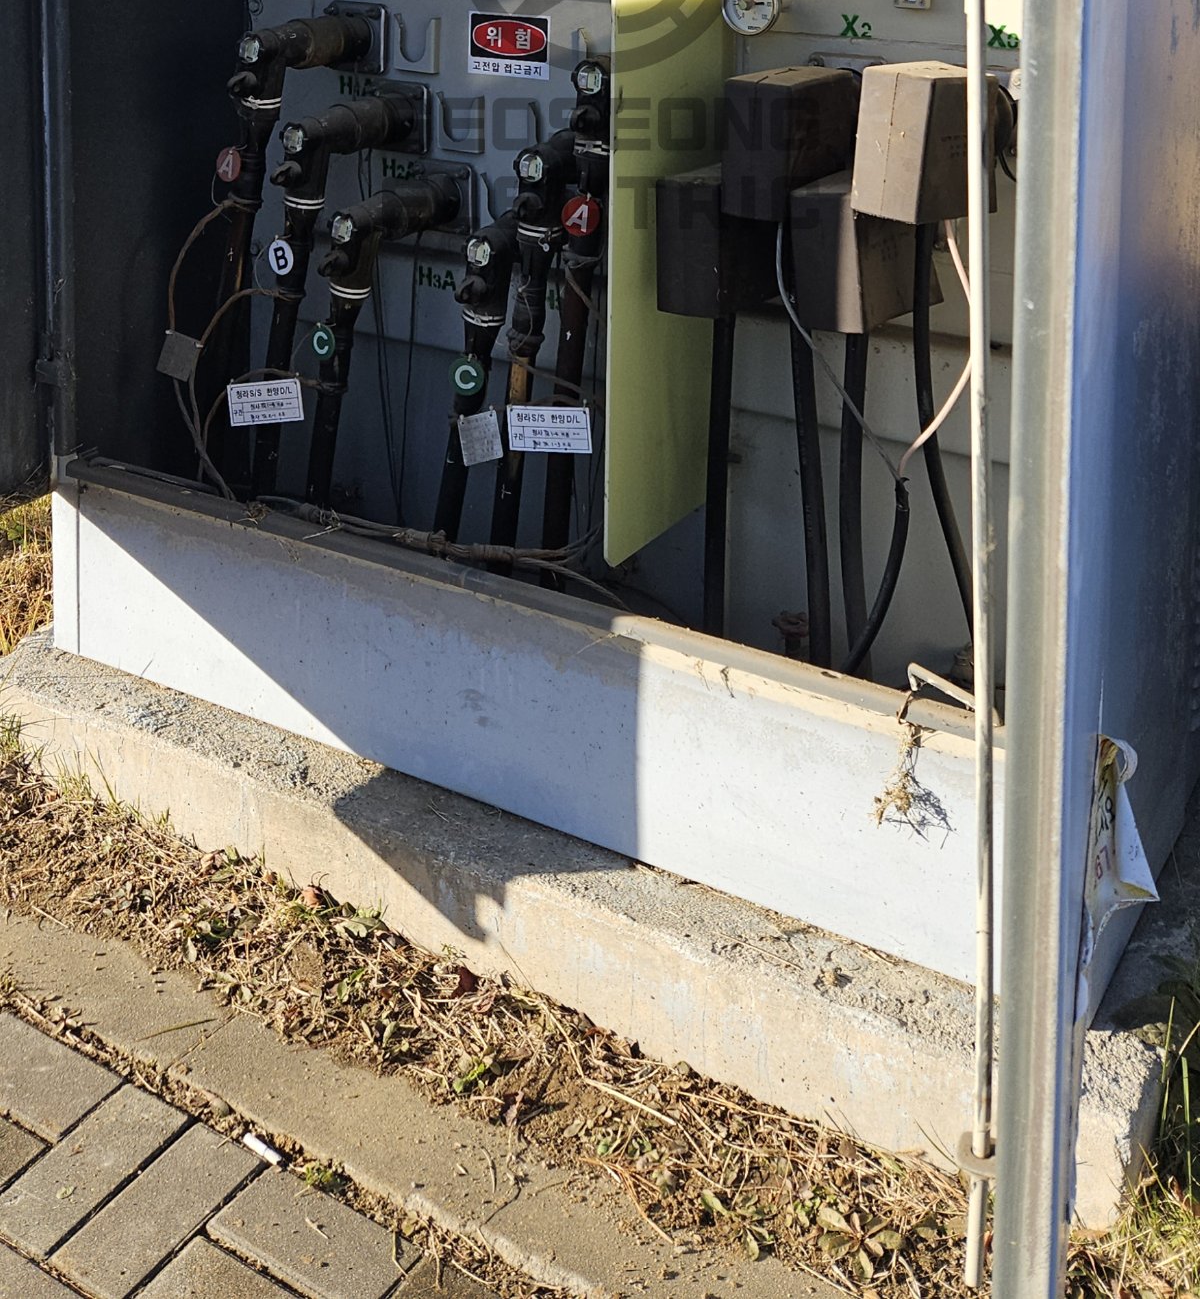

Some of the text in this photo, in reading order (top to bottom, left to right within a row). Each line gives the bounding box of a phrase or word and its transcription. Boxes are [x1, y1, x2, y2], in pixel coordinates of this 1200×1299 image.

[840, 14, 872, 38] X2
[473, 60, 541, 76] 고전압 접근금지
[218, 154, 233, 179] A
[566, 204, 589, 233] A
[273, 246, 288, 271] B
[418, 265, 457, 292] H3A
[313, 331, 329, 354] C
[454, 364, 478, 390] C
